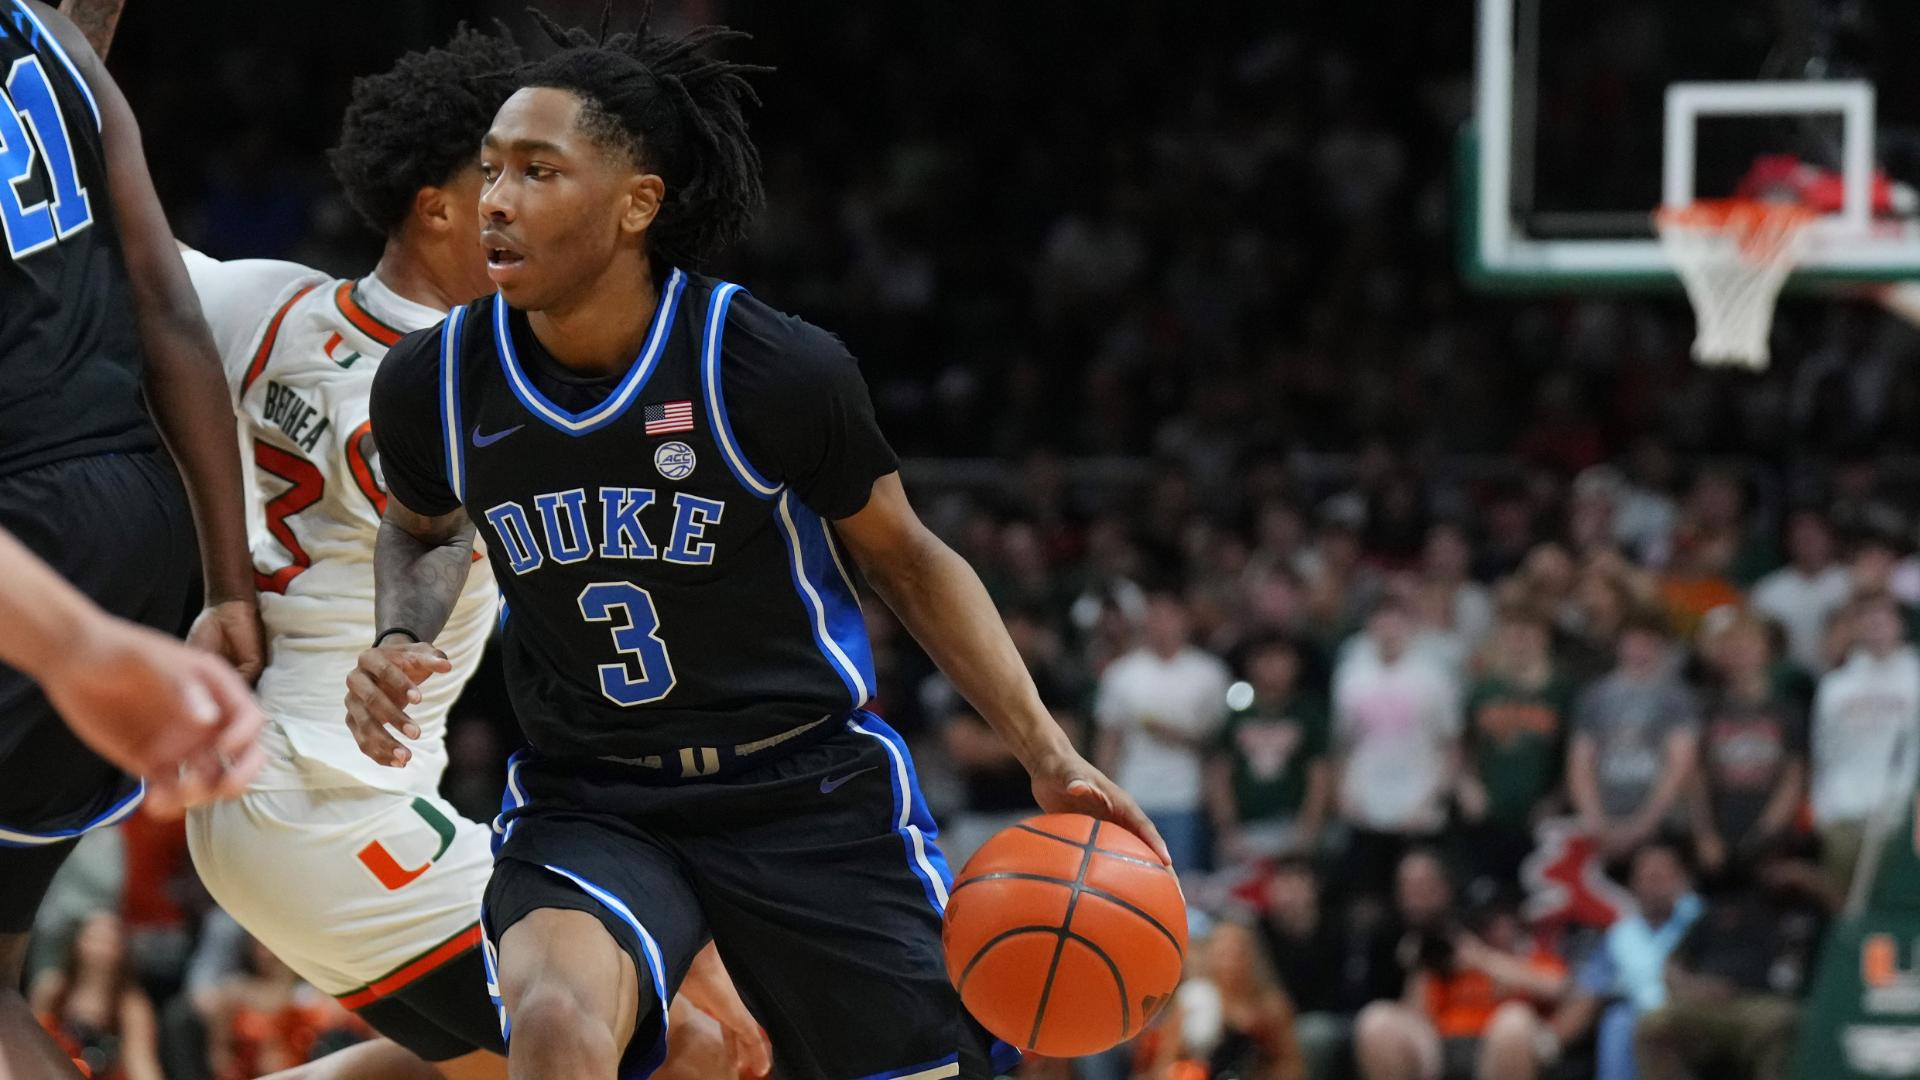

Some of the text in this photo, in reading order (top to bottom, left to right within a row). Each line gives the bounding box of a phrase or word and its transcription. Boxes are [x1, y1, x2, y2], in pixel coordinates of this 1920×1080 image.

[262, 379, 331, 453] BETHEA
[661, 452, 692, 464] ACC
[484, 486, 726, 576] DUKE
[576, 580, 677, 708] 3
